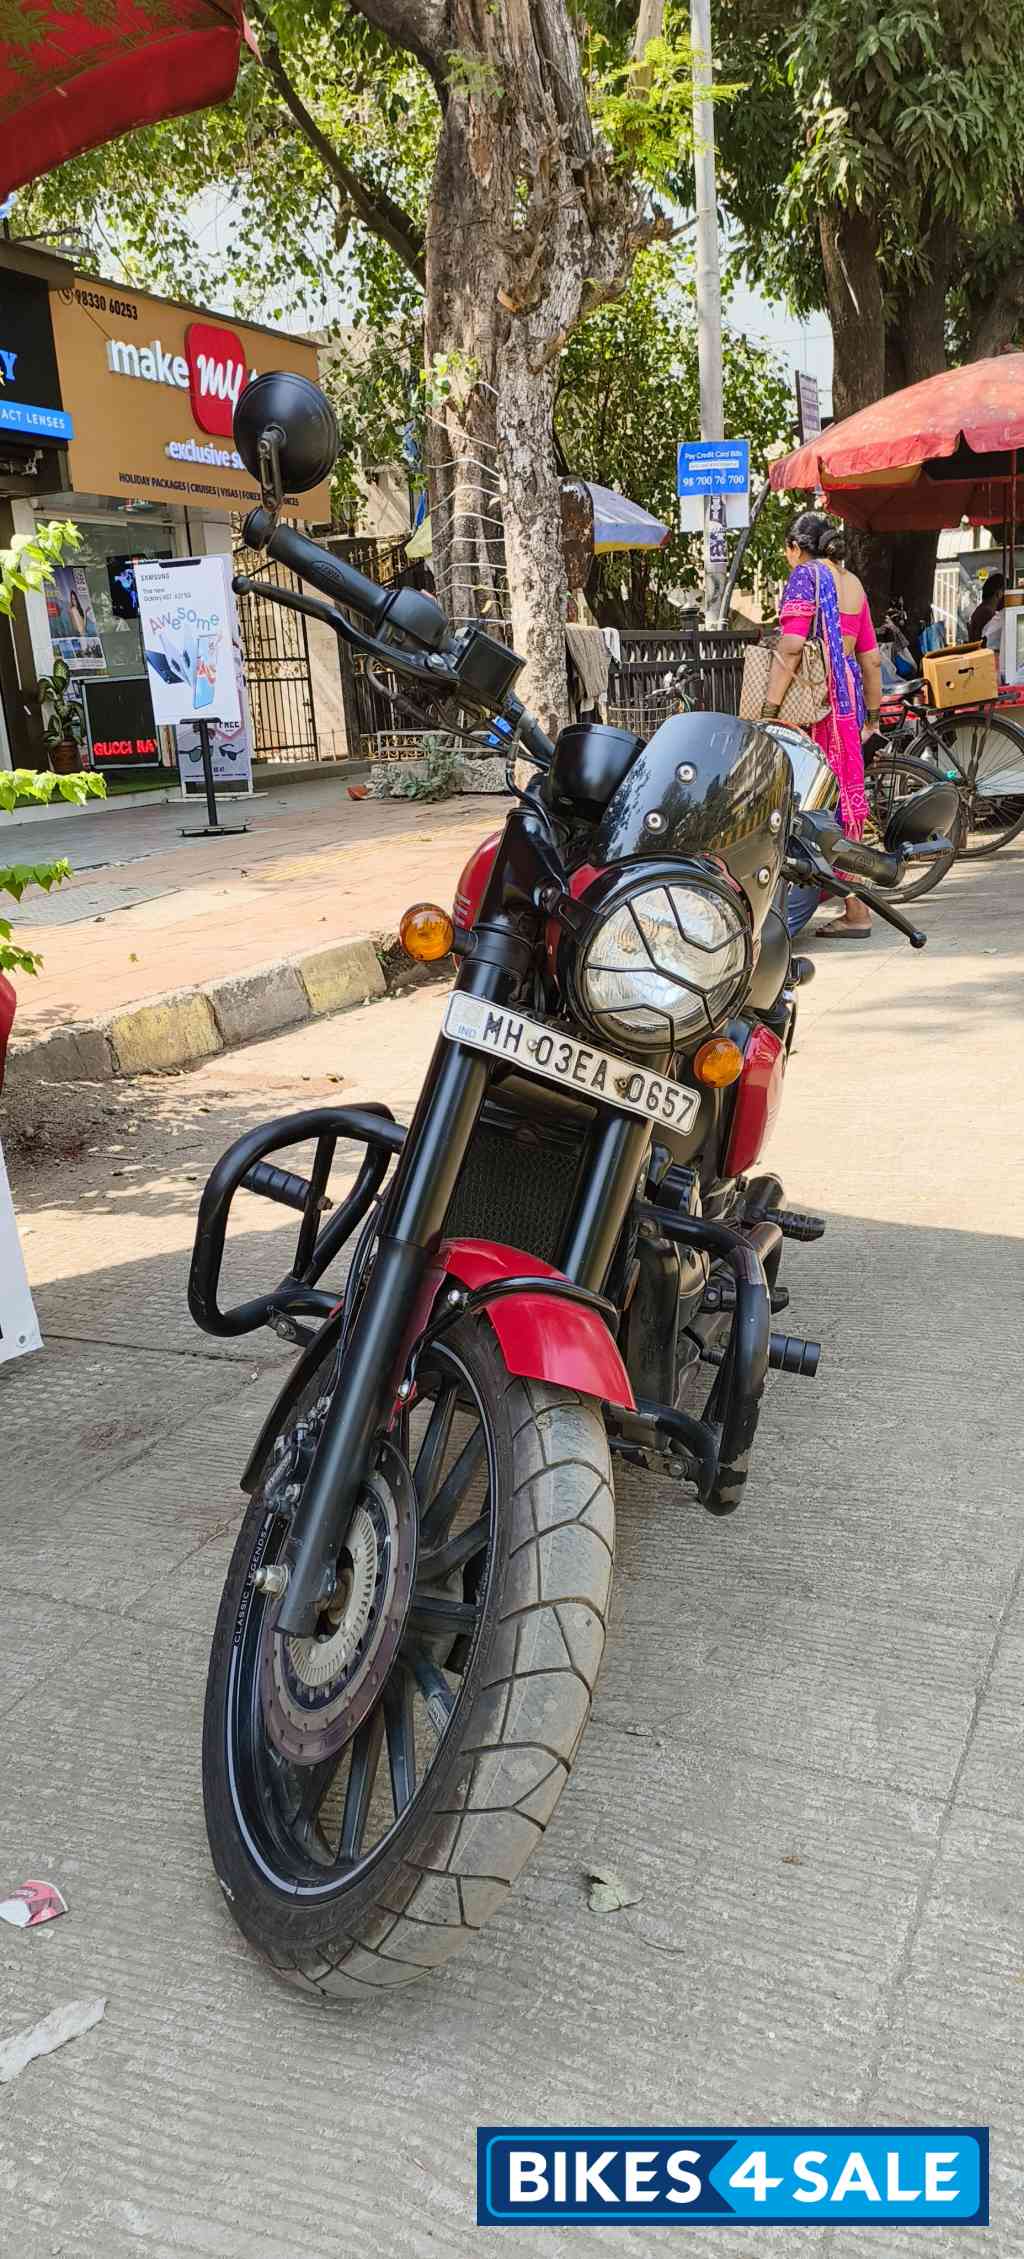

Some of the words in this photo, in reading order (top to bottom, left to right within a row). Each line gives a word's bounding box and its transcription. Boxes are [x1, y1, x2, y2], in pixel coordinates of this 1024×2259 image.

[75, 289, 106, 311] 98330
[109, 299, 138, 321] 60253
[106, 339, 190, 389] make
[196, 353, 244, 416] my
[26, 412, 65, 429] LENSES
[166, 439, 230, 467] exclusive
[696, 451, 714, 459] Credit
[119, 472, 151, 486] HOLIDAY
[151, 477, 186, 491] PACKAGES
[190, 484, 217, 495] CRUISES
[220, 487, 239, 498] VISAS
[695, 476, 713, 486] 700
[728, 475, 744, 485] 700
[93, 740, 133, 756] GUCCI
[483, 1012, 524, 1053] MH
[534, 1035, 608, 1092] 03EA
[625, 1073, 695, 1125] 0657
[234, 1590, 250, 1643] CLASSIC
[247, 1530, 267, 1587] LEGENDS
